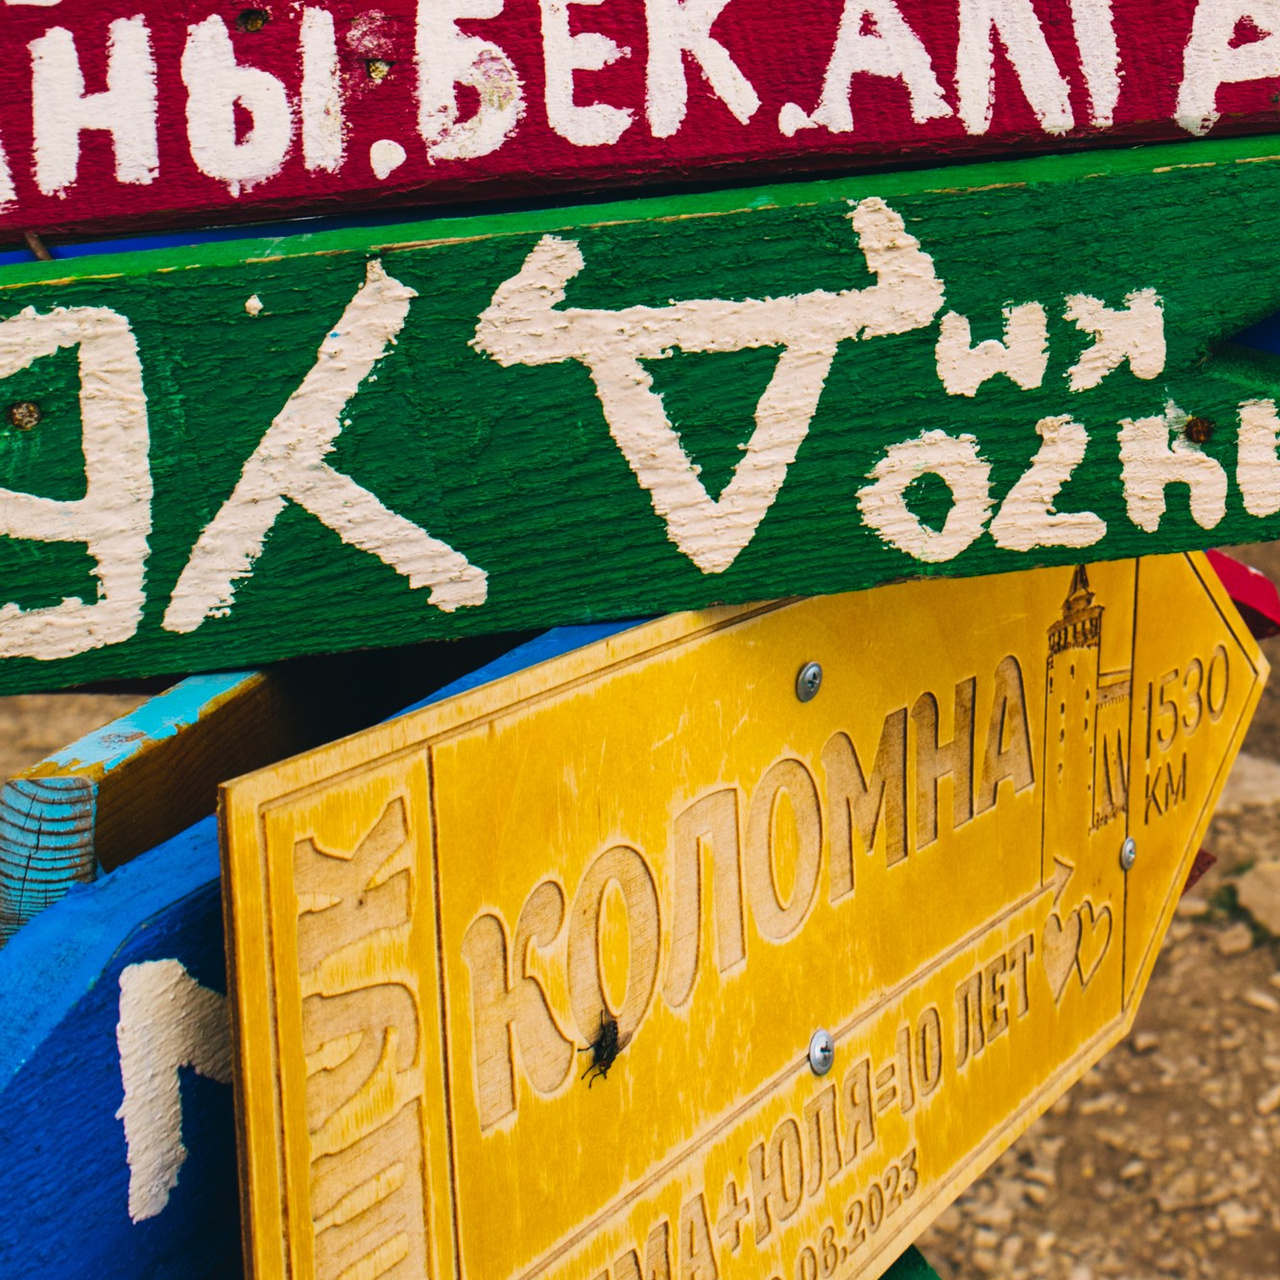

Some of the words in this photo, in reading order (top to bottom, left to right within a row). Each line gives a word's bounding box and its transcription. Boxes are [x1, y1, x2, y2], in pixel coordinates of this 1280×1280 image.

[935, 287, 1166, 398] КМ
[1143, 644, 1230, 762] 1530
[1144, 751, 1188, 826] КМ
[459, 654, 1036, 1133] КОЛОМНА
[954, 933, 1036, 1070] ЛЕТ
